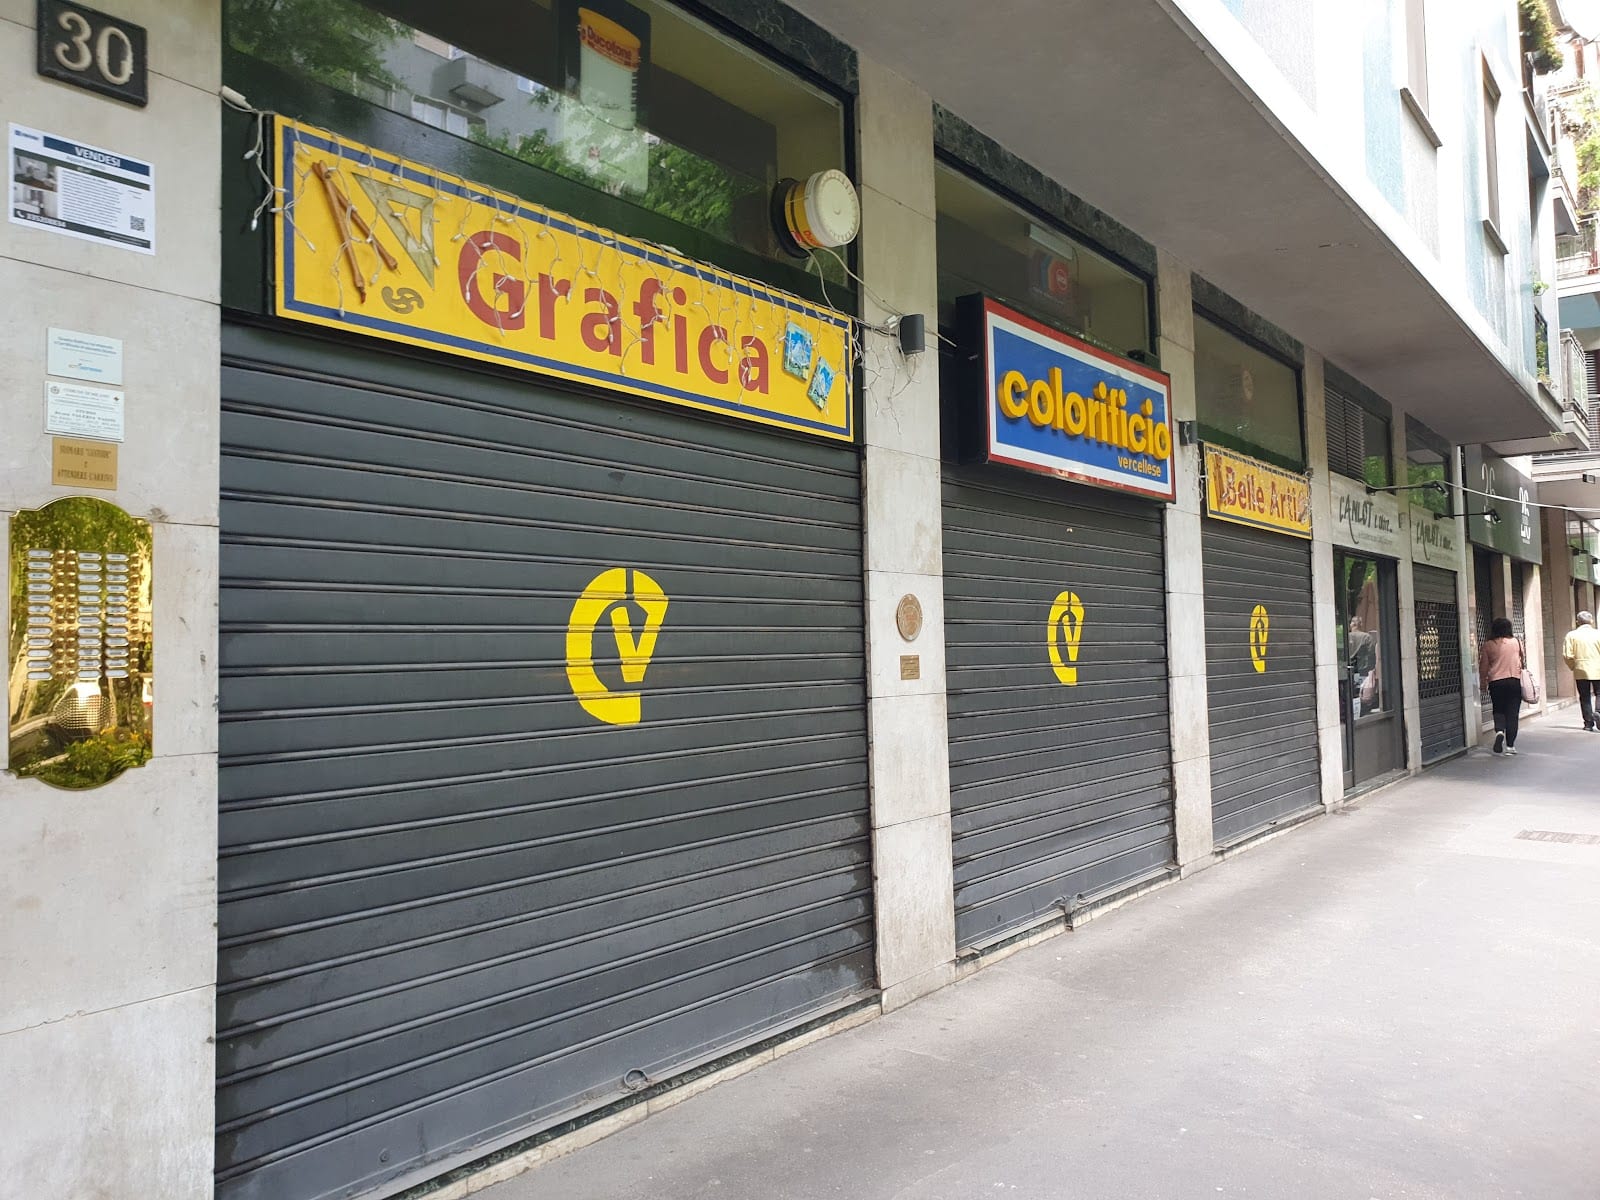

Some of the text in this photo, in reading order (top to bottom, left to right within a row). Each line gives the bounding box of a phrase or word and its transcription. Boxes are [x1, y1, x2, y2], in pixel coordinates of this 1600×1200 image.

[54, 11, 134, 86] 30
[74, 146, 121, 168] VENDESI
[458, 230, 769, 395] Grafica
[997, 366, 1171, 460] colorificio
[1117, 455, 1162, 478] vercellese
[1226, 466, 1265, 514] Belle
